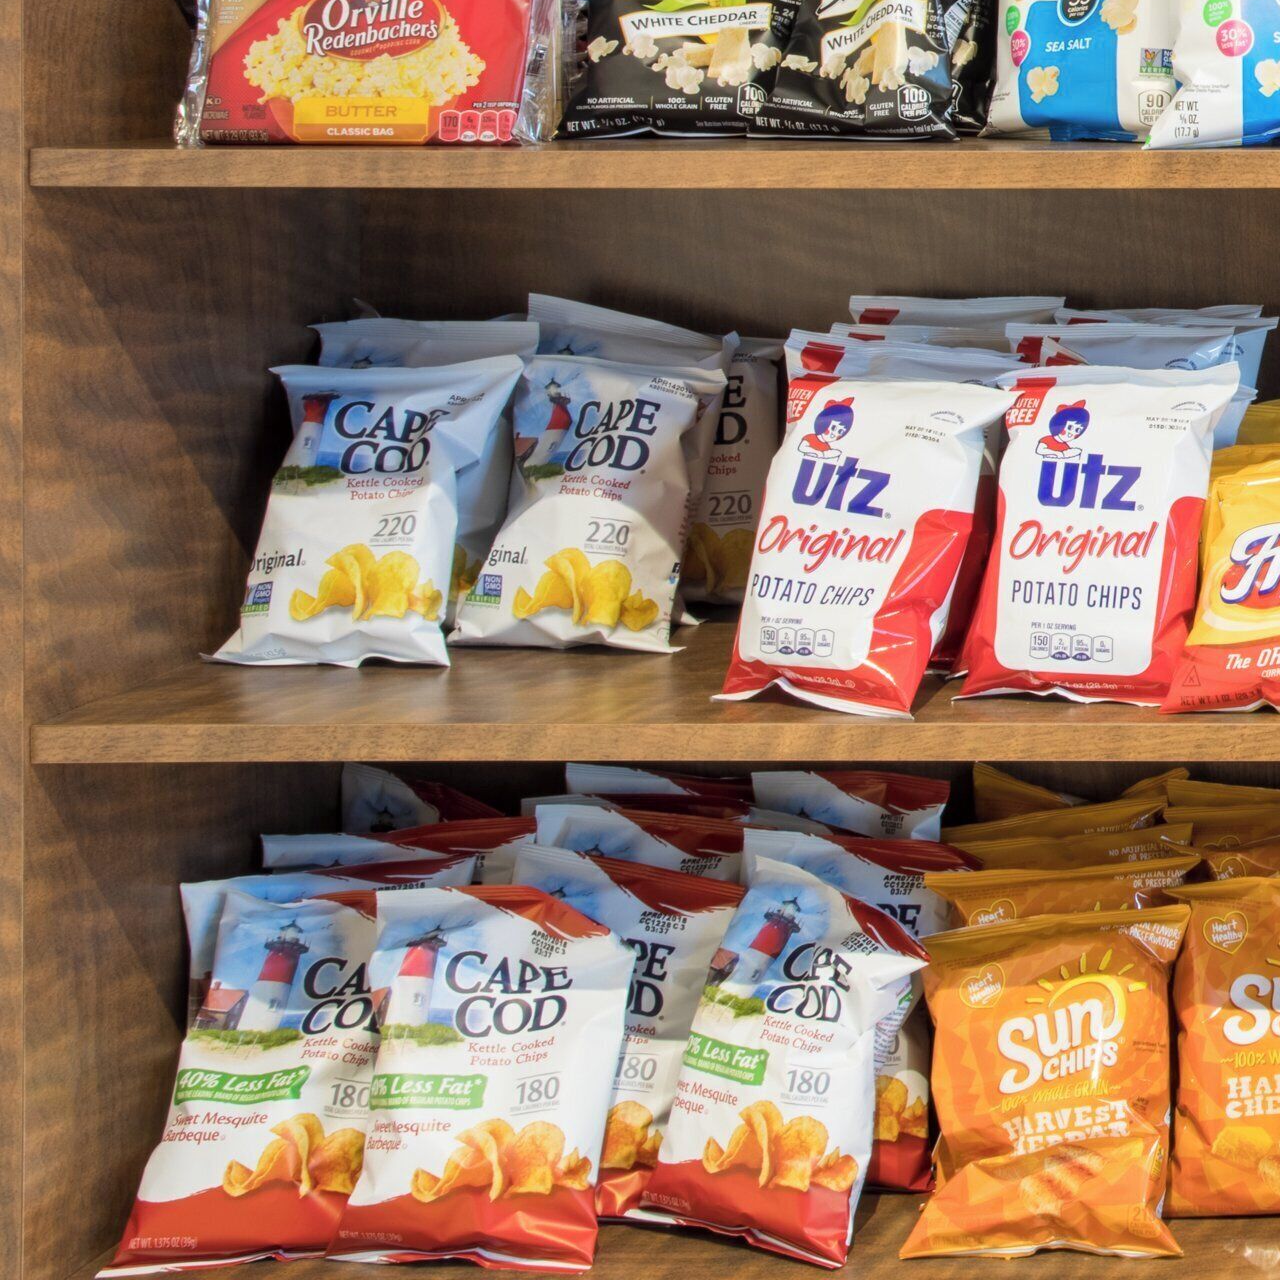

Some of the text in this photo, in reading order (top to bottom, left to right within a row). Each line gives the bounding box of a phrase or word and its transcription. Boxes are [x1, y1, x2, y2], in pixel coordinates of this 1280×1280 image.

[631, 9, 757, 31] WHITE CHEDDAR
[304, 20, 440, 58] Redenbacher's
[325, 105, 398, 118] BUTTER
[705, 96, 733, 104] GLUTEN
[327, 127, 394, 136] CLASSIC BAG
[574, 399, 661, 438] CAPE
[565, 438, 651, 473] COD
[346, 477, 424, 488] Kettle Cooked
[373, 514, 417, 538] 220
[586, 520, 629, 545] 220
[758, 516, 906, 573] Original
[1010, 520, 1158, 574] Original
[1012, 579, 1142, 610] POTATO CHIPS
[1211, 918, 1237, 934] Heart
[1212, 927, 1243, 944] Healthy
[445, 949, 573, 995] CAPE
[455, 995, 567, 1039] COD
[997, 994, 1125, 1094] Sun
[1043, 1040, 1118, 1081] CHIPS
[1234, 1052, 1266, 1069] 100%
[225, 1070, 266, 1092] Less
[786, 1068, 831, 1095] 180
[202, 1110, 268, 1128] Mesquite
